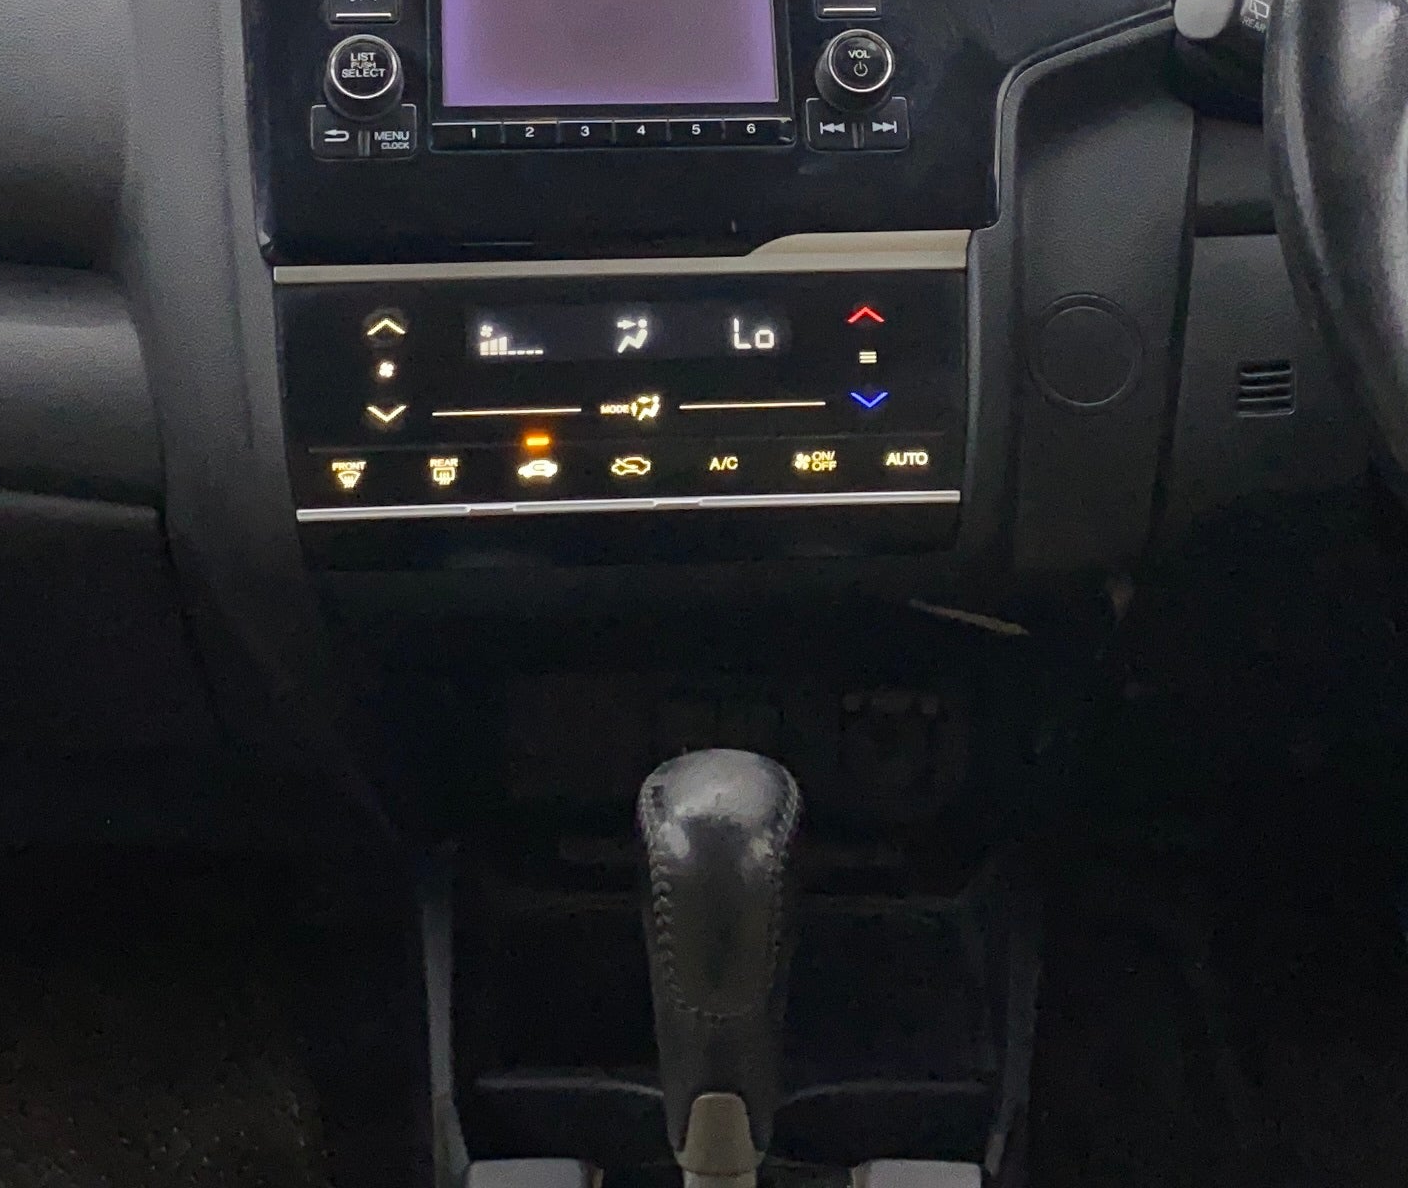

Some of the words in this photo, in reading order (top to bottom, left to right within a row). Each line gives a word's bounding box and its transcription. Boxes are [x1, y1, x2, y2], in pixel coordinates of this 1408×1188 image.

[350, 52, 376, 62] LIST
[848, 49, 871, 59] VOL
[350, 61, 377, 69] PUSH
[341, 68, 386, 78] SELECT
[471, 127, 477, 139] 1
[524, 126, 535, 138] 2
[580, 125, 591, 137] 3
[636, 124, 647, 136] 4
[691, 123, 701, 135] 5
[746, 123, 756, 135] 6
[373, 130, 410, 141] MENU
[380, 141, 410, 150] CLOCK
[599, 404, 630, 415] MODE
[811, 450, 836, 461] ON/
[885, 451, 929, 466] AUTO
[331, 461, 367, 472] FRONT
[429, 457, 459, 468] REAR
[709, 455, 739, 471] A/C
[811, 460, 838, 472] OFF
